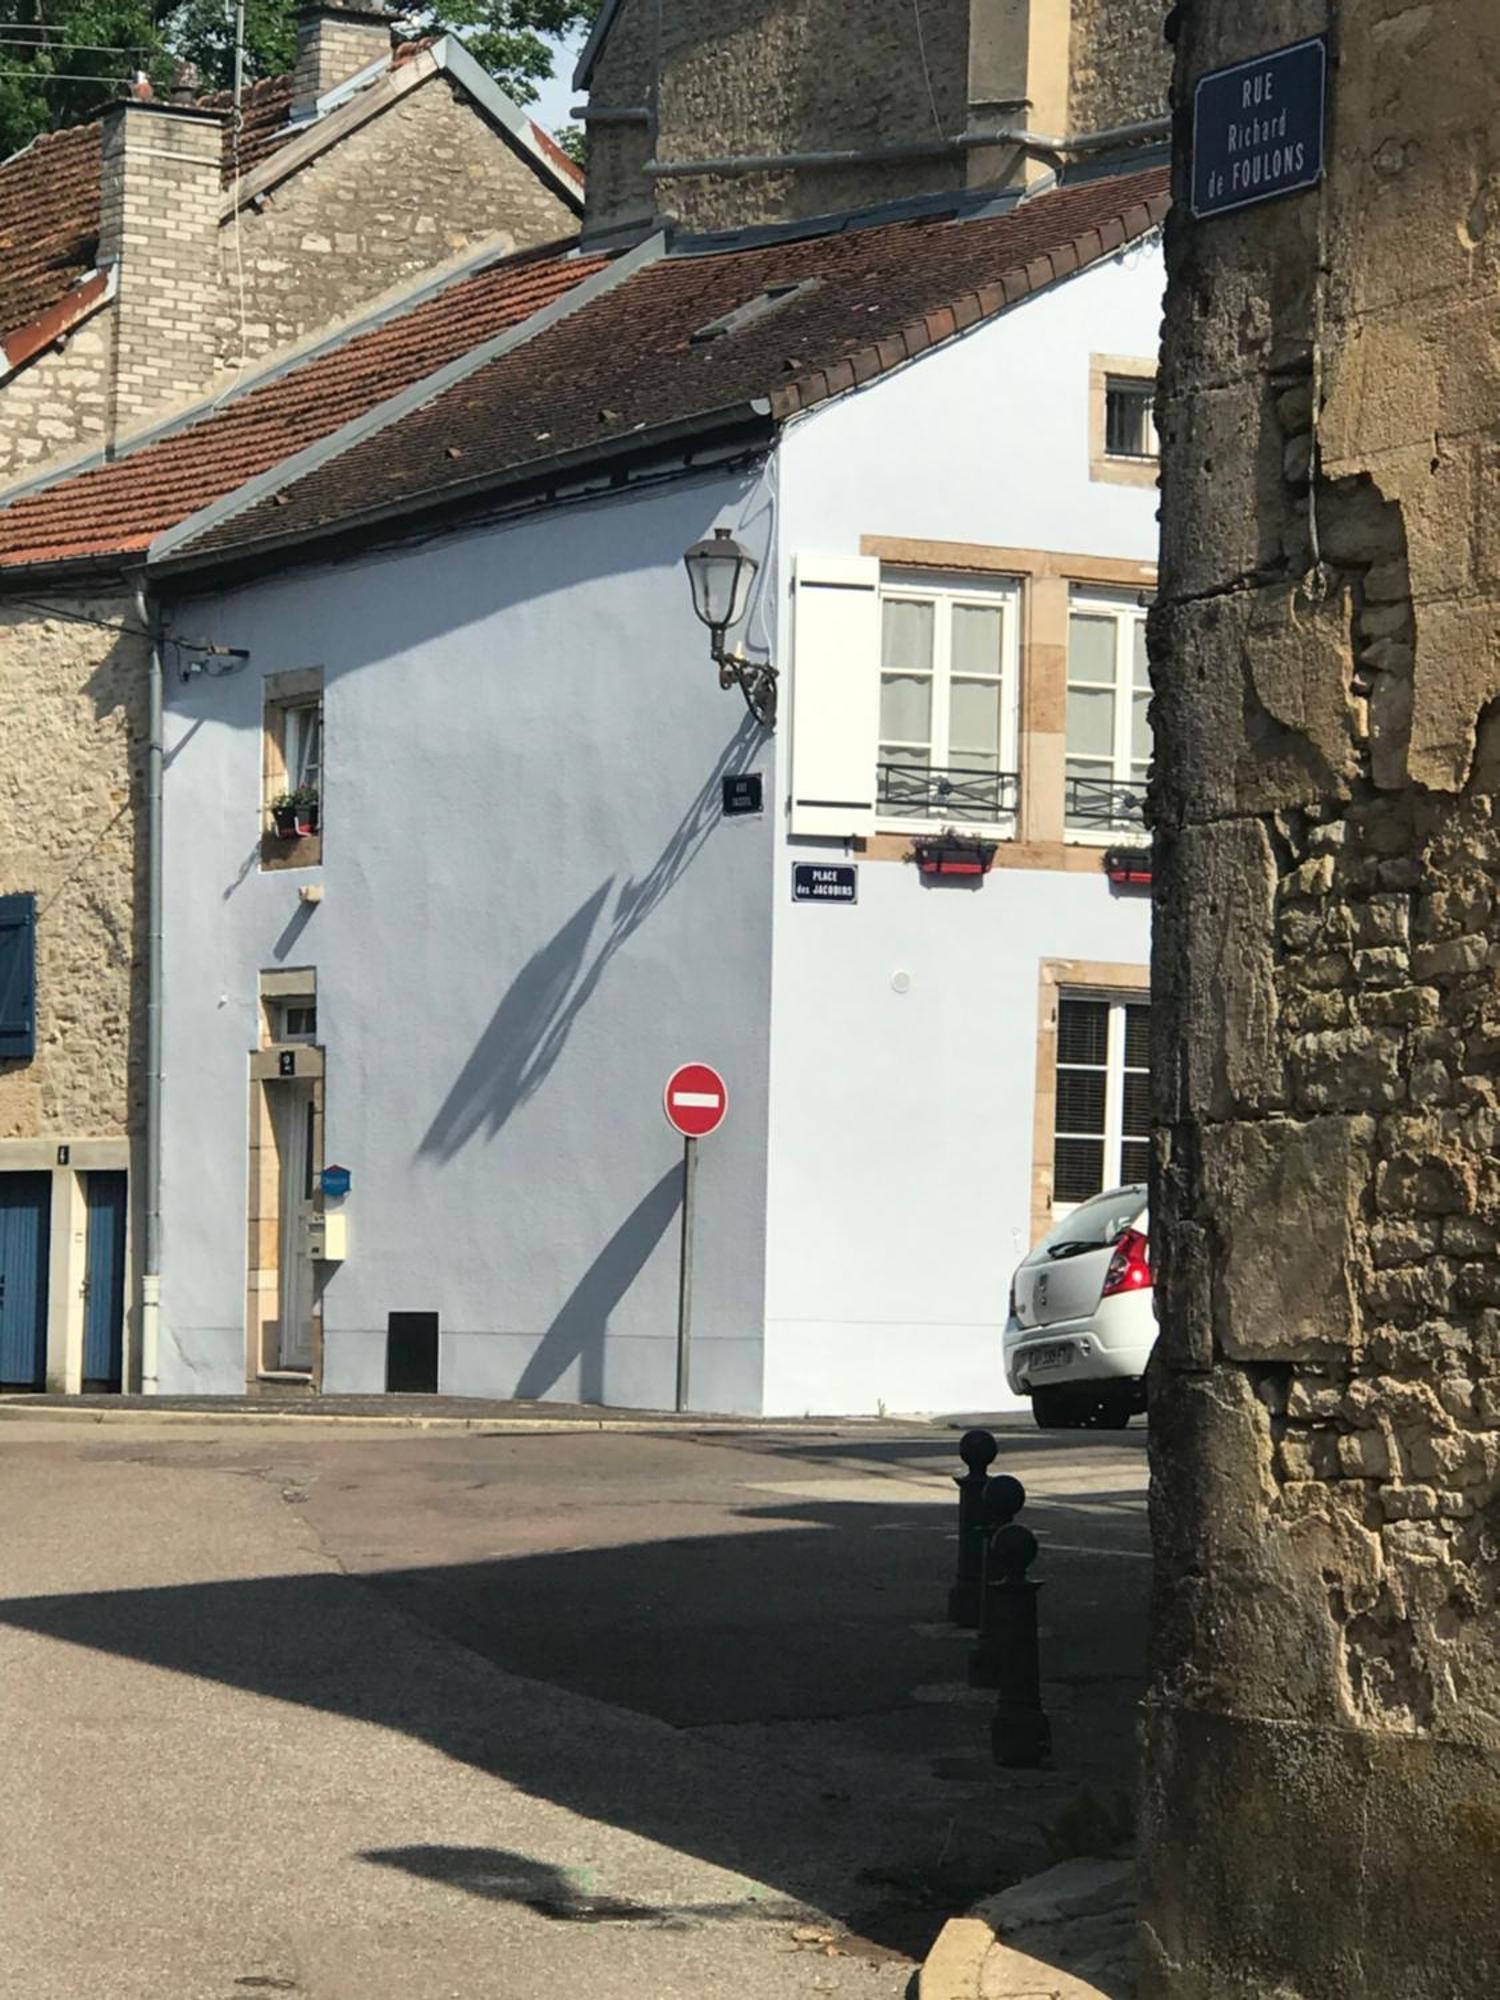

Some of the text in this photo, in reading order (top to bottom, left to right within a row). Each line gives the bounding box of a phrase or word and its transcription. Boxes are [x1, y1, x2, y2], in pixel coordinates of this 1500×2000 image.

[1242, 72, 1273, 108] RUE
[1228, 107, 1287, 152] Richard
[1208, 142, 1304, 199] de FOULONS
[797, 884, 852, 896] des JACOBINS
[812, 870, 837, 882] PLACE
